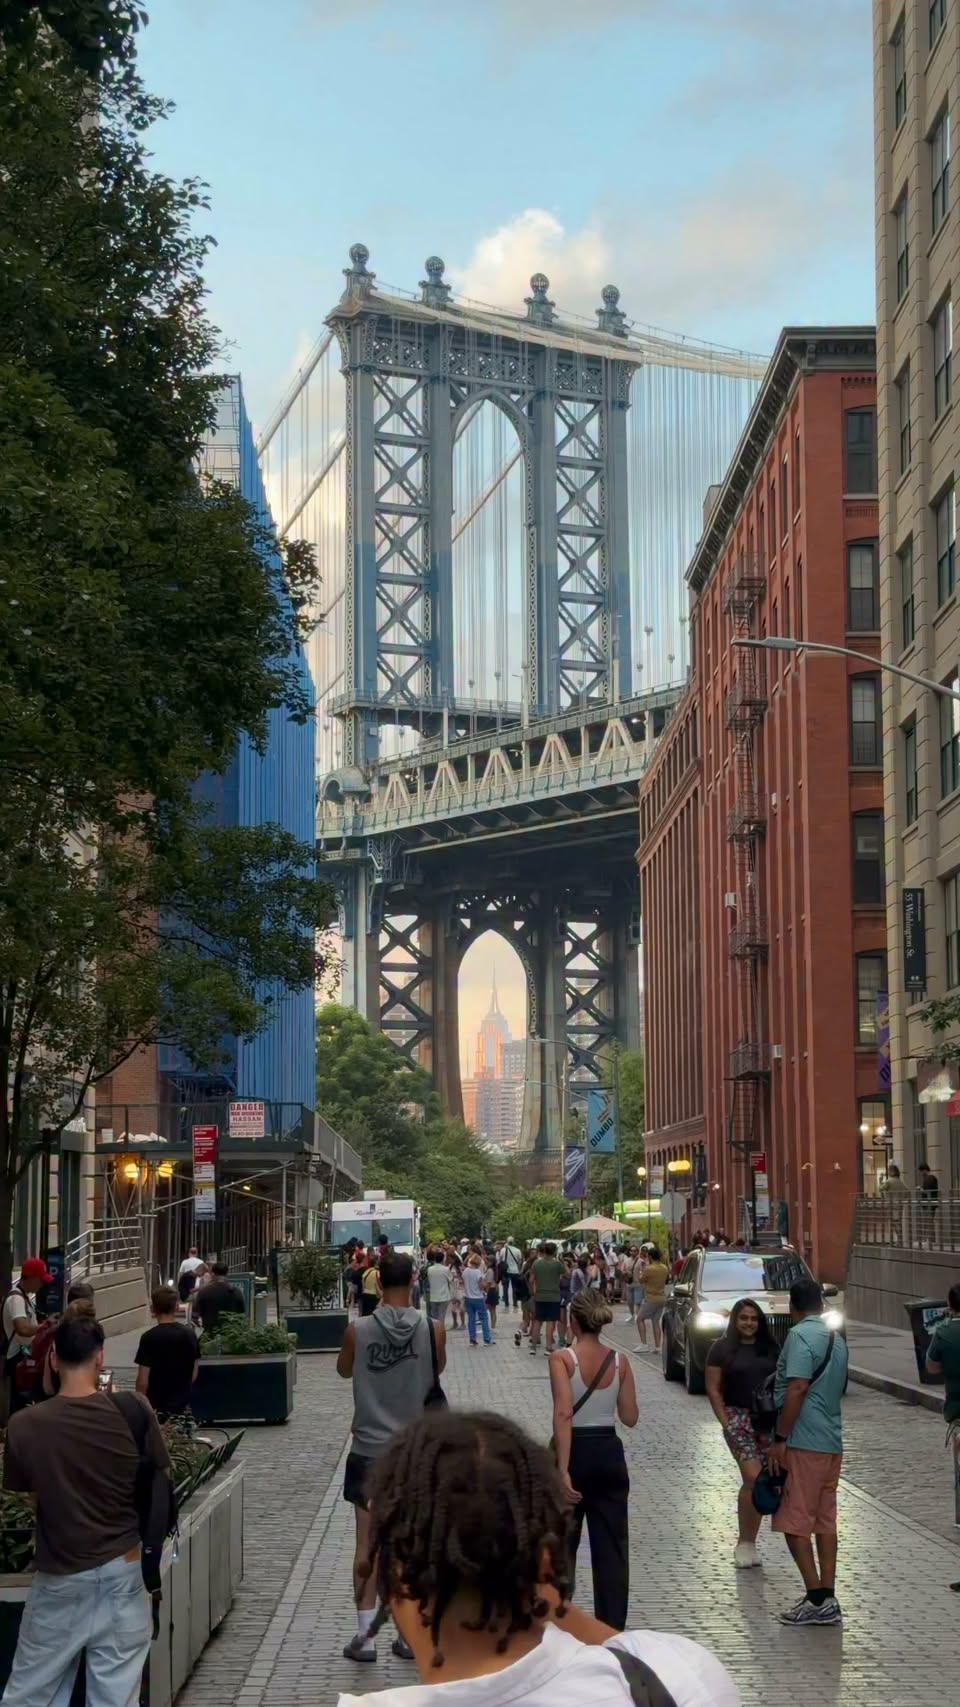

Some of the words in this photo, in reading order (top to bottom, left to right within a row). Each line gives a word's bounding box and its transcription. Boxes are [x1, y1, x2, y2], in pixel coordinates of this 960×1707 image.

[904, 904, 913, 947] Washington
[230, 1103, 264, 1111] DANGER
[590, 1117, 614, 1147] DUMBO
